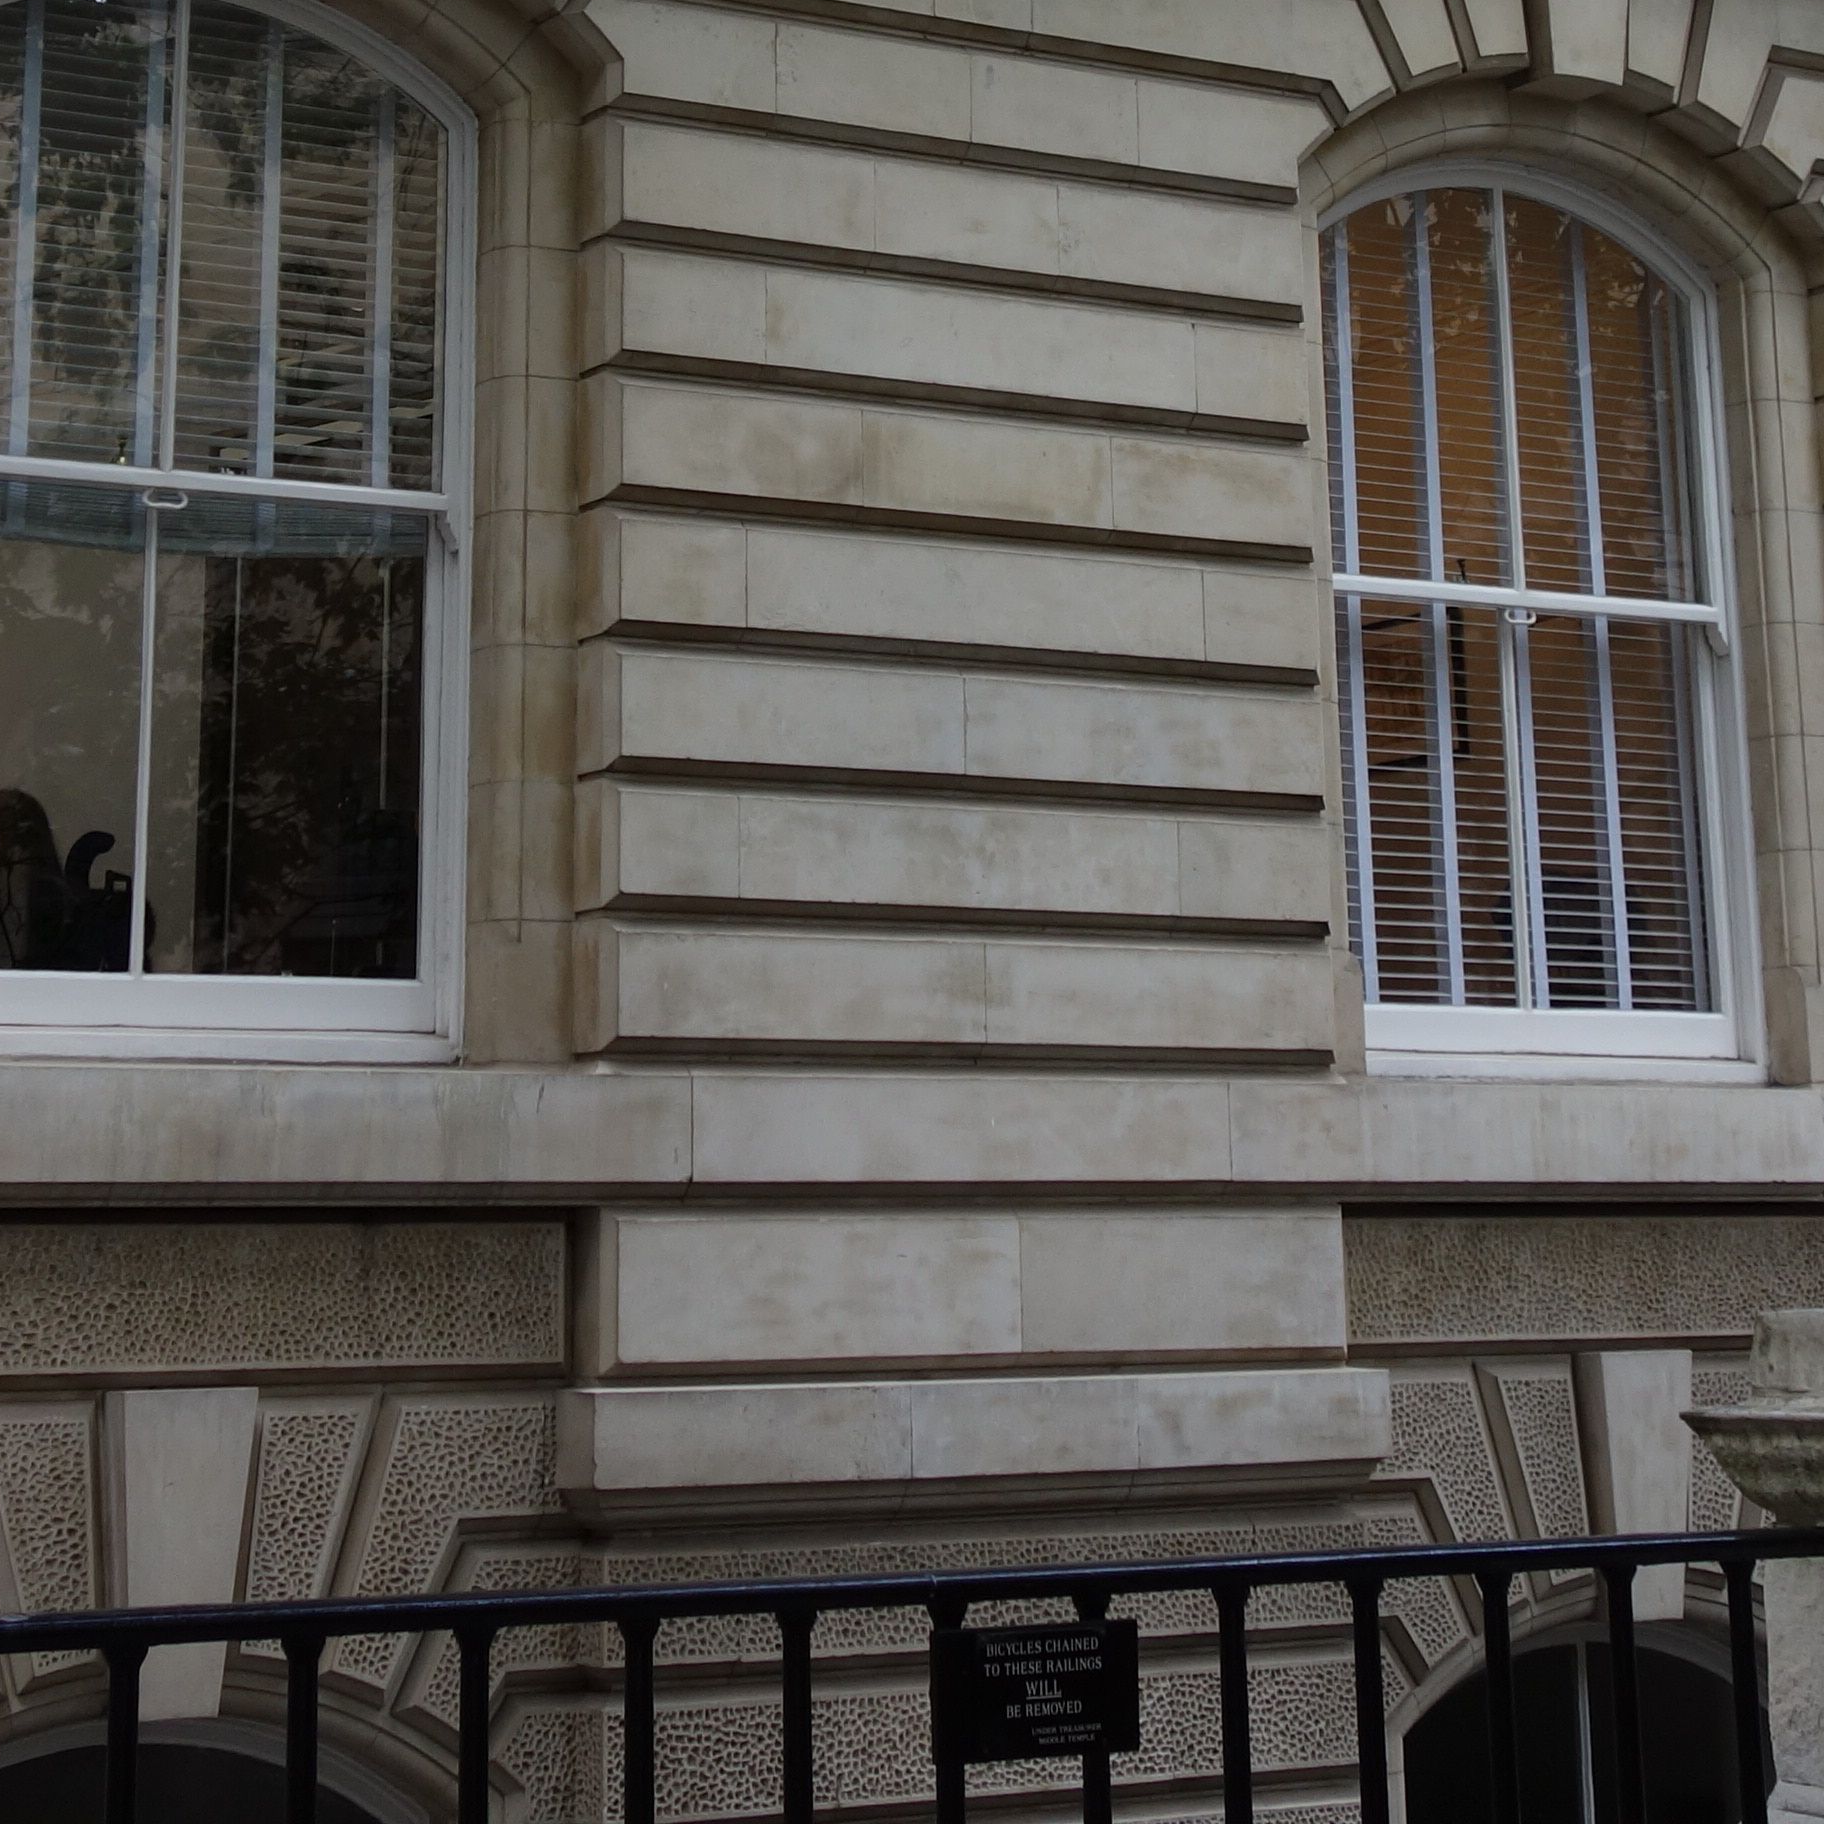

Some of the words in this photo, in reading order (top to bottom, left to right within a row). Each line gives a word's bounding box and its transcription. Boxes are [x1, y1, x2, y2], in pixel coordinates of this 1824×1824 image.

[986, 1640, 1041, 1657] BICYCLES
[1045, 1636, 1099, 1653] CHAINED
[984, 1663, 1000, 1677] TO
[1004, 1660, 1042, 1676] THESE
[1046, 1655, 1102, 1673] RAILINGS
[1025, 1679, 1062, 1699] WILL
[1006, 1704, 1021, 1719] BE
[1025, 1700, 1082, 1717] REMOVED
